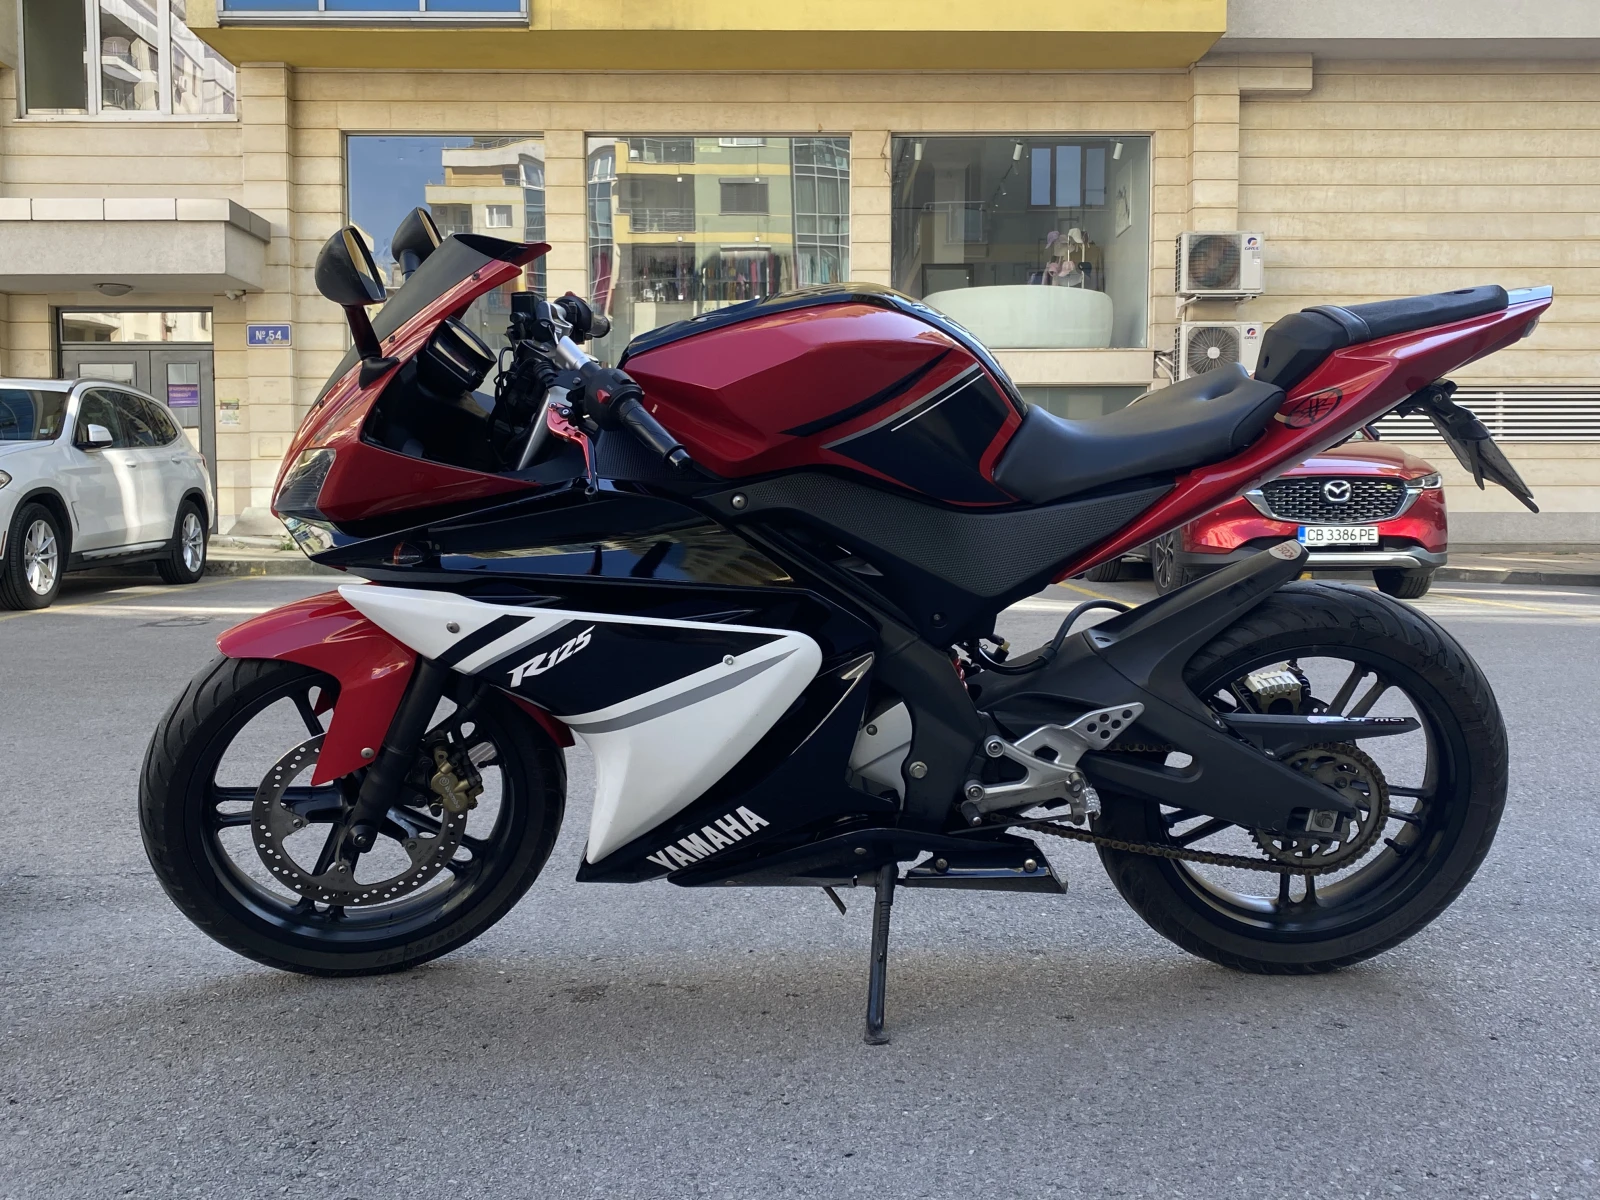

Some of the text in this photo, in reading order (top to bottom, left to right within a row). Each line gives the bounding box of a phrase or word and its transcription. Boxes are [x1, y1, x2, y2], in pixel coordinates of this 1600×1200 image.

[268, 330, 282, 341] 54
[1307, 528, 1376, 541] CB 3386 PE
[506, 624, 596, 688] R125
[645, 805, 770, 871] YAMAHA
